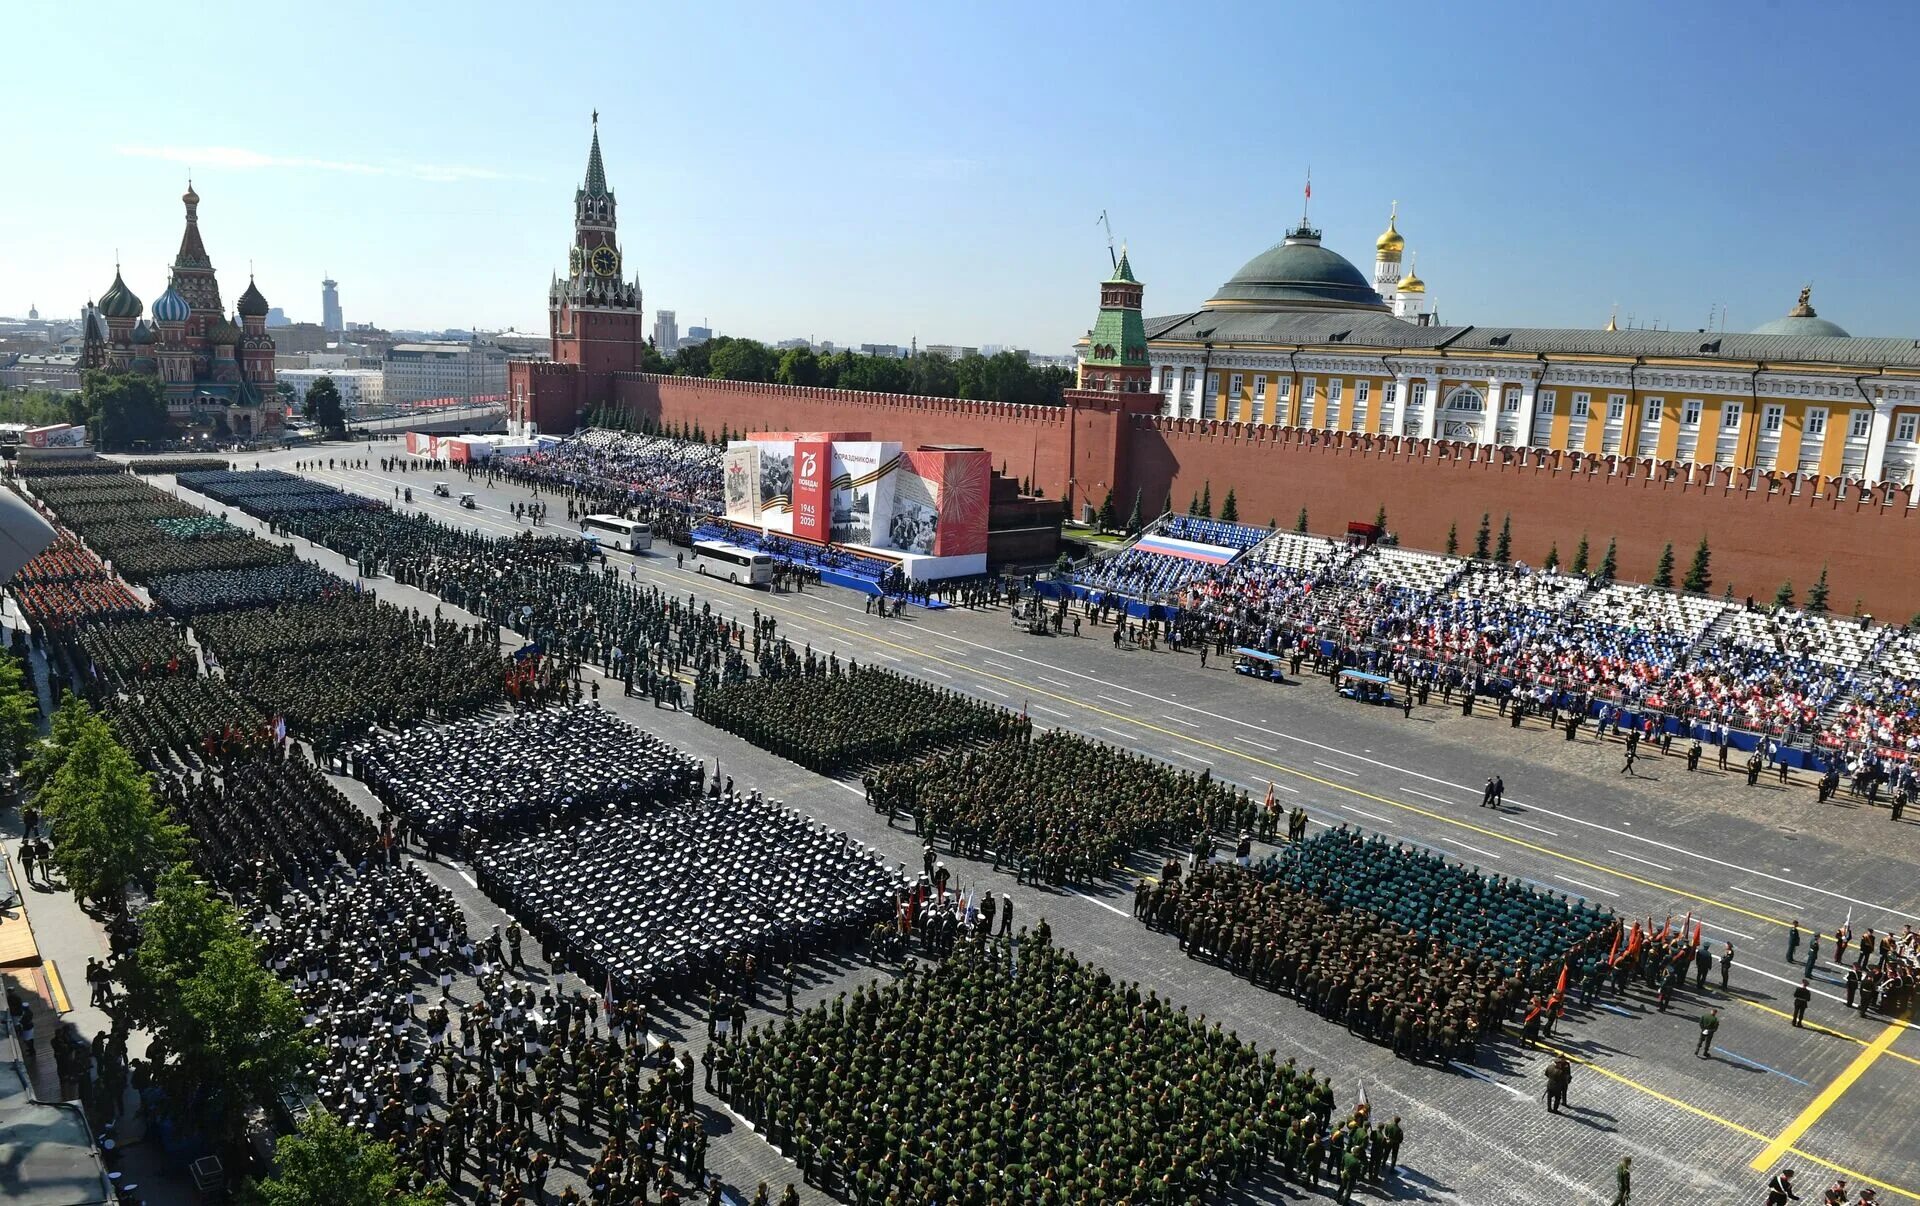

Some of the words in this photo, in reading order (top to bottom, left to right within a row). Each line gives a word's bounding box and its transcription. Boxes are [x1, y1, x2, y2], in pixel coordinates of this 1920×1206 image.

[838, 453, 876, 463] ПРАЗДНИКОМ!
[801, 451, 817, 477] 75
[798, 478, 818, 488] ПОБЕДА!
[800, 504, 815, 514] 1945
[800, 516, 815, 527] 2020
